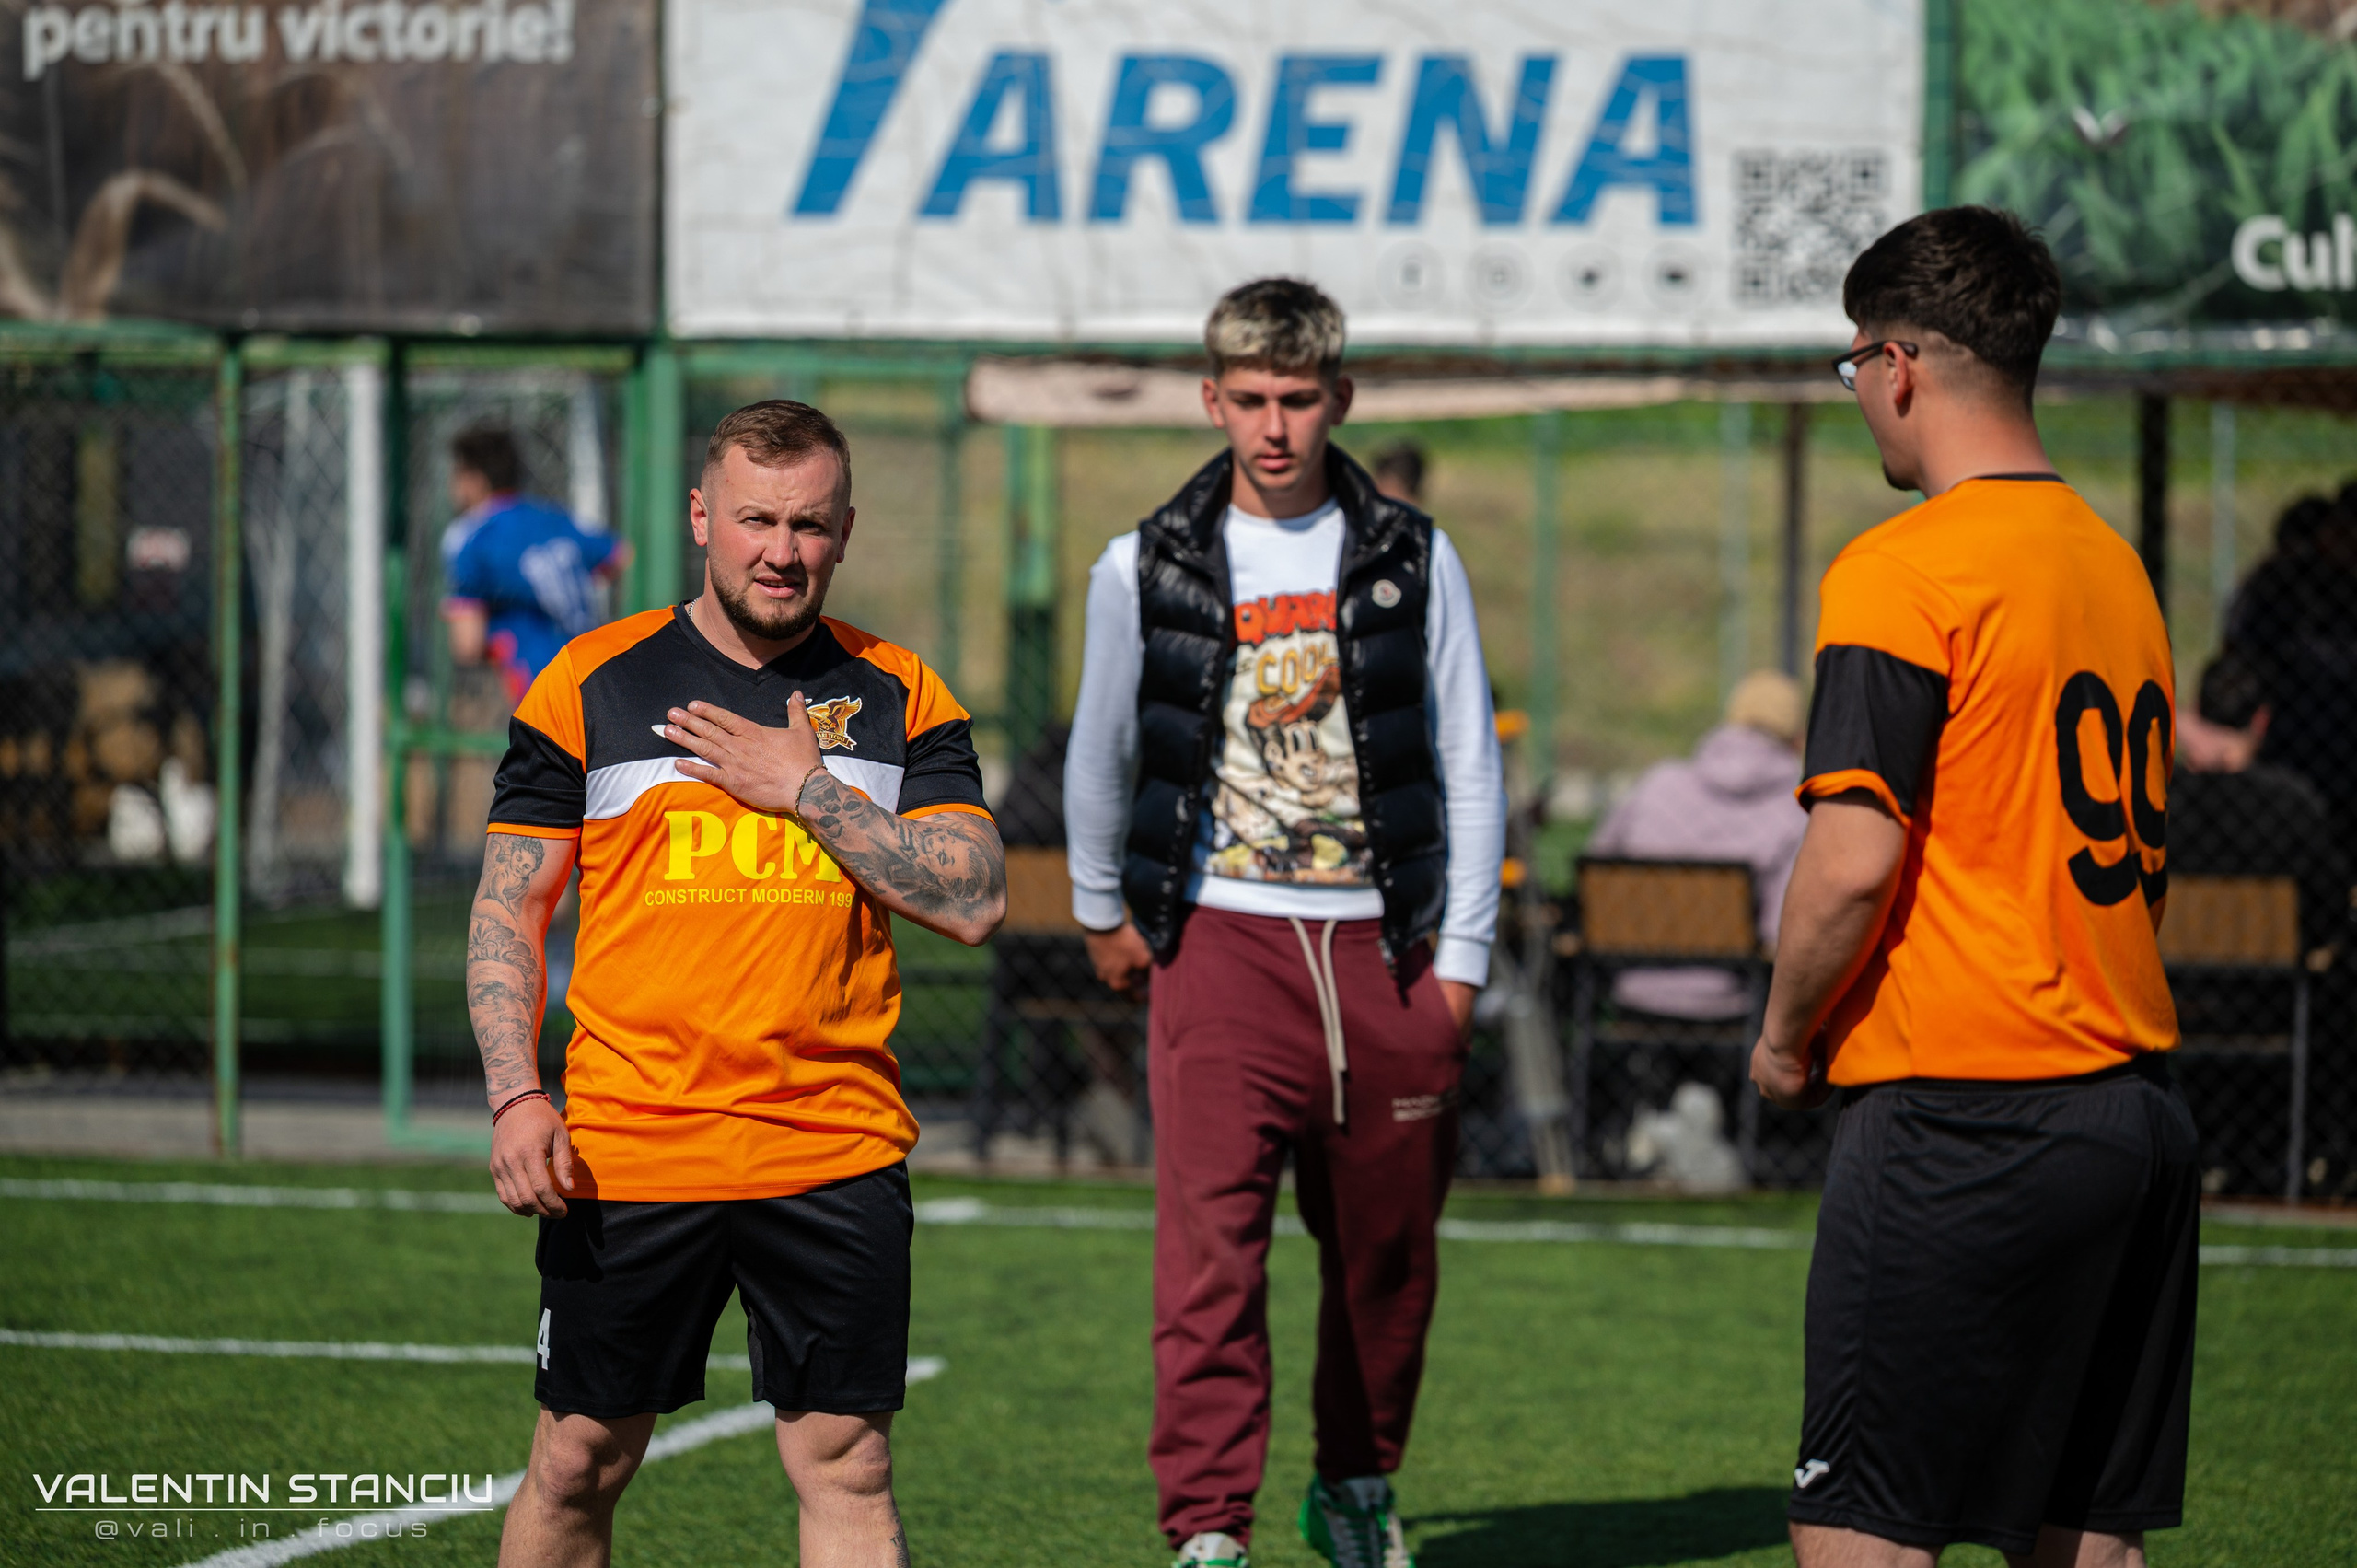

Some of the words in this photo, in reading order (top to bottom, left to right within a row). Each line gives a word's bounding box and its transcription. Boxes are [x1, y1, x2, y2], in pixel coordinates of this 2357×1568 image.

[22, 1, 267, 81] pentru
[279, 0, 576, 63] victorie!
[919, 53, 1698, 227] ARENA
[2231, 212, 2357, 292] Cul
[2055, 670, 2171, 909] 99
[664, 811, 842, 882] PCM
[644, 888, 747, 906] CONSTRUCT
[752, 888, 825, 905] MODERN
[829, 891, 853, 908] 199
[537, 1307, 552, 1371] 4
